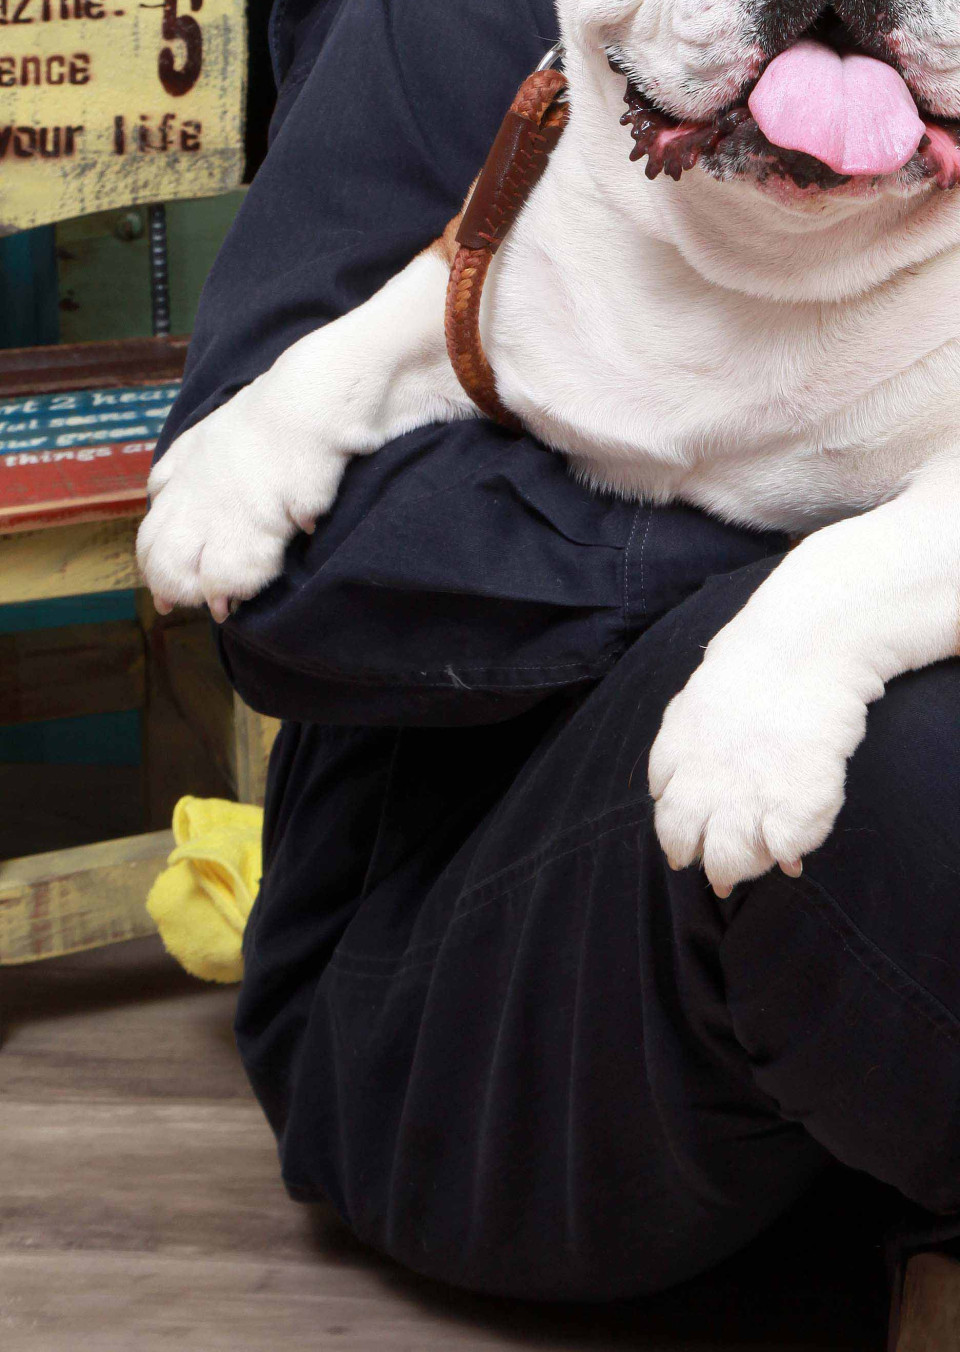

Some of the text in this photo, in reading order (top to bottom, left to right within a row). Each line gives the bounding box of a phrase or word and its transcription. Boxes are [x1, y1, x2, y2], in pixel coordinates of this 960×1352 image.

[0, 53, 91, 87] ence
[114, 112, 203, 156] life
[4, 444, 113, 468] things
